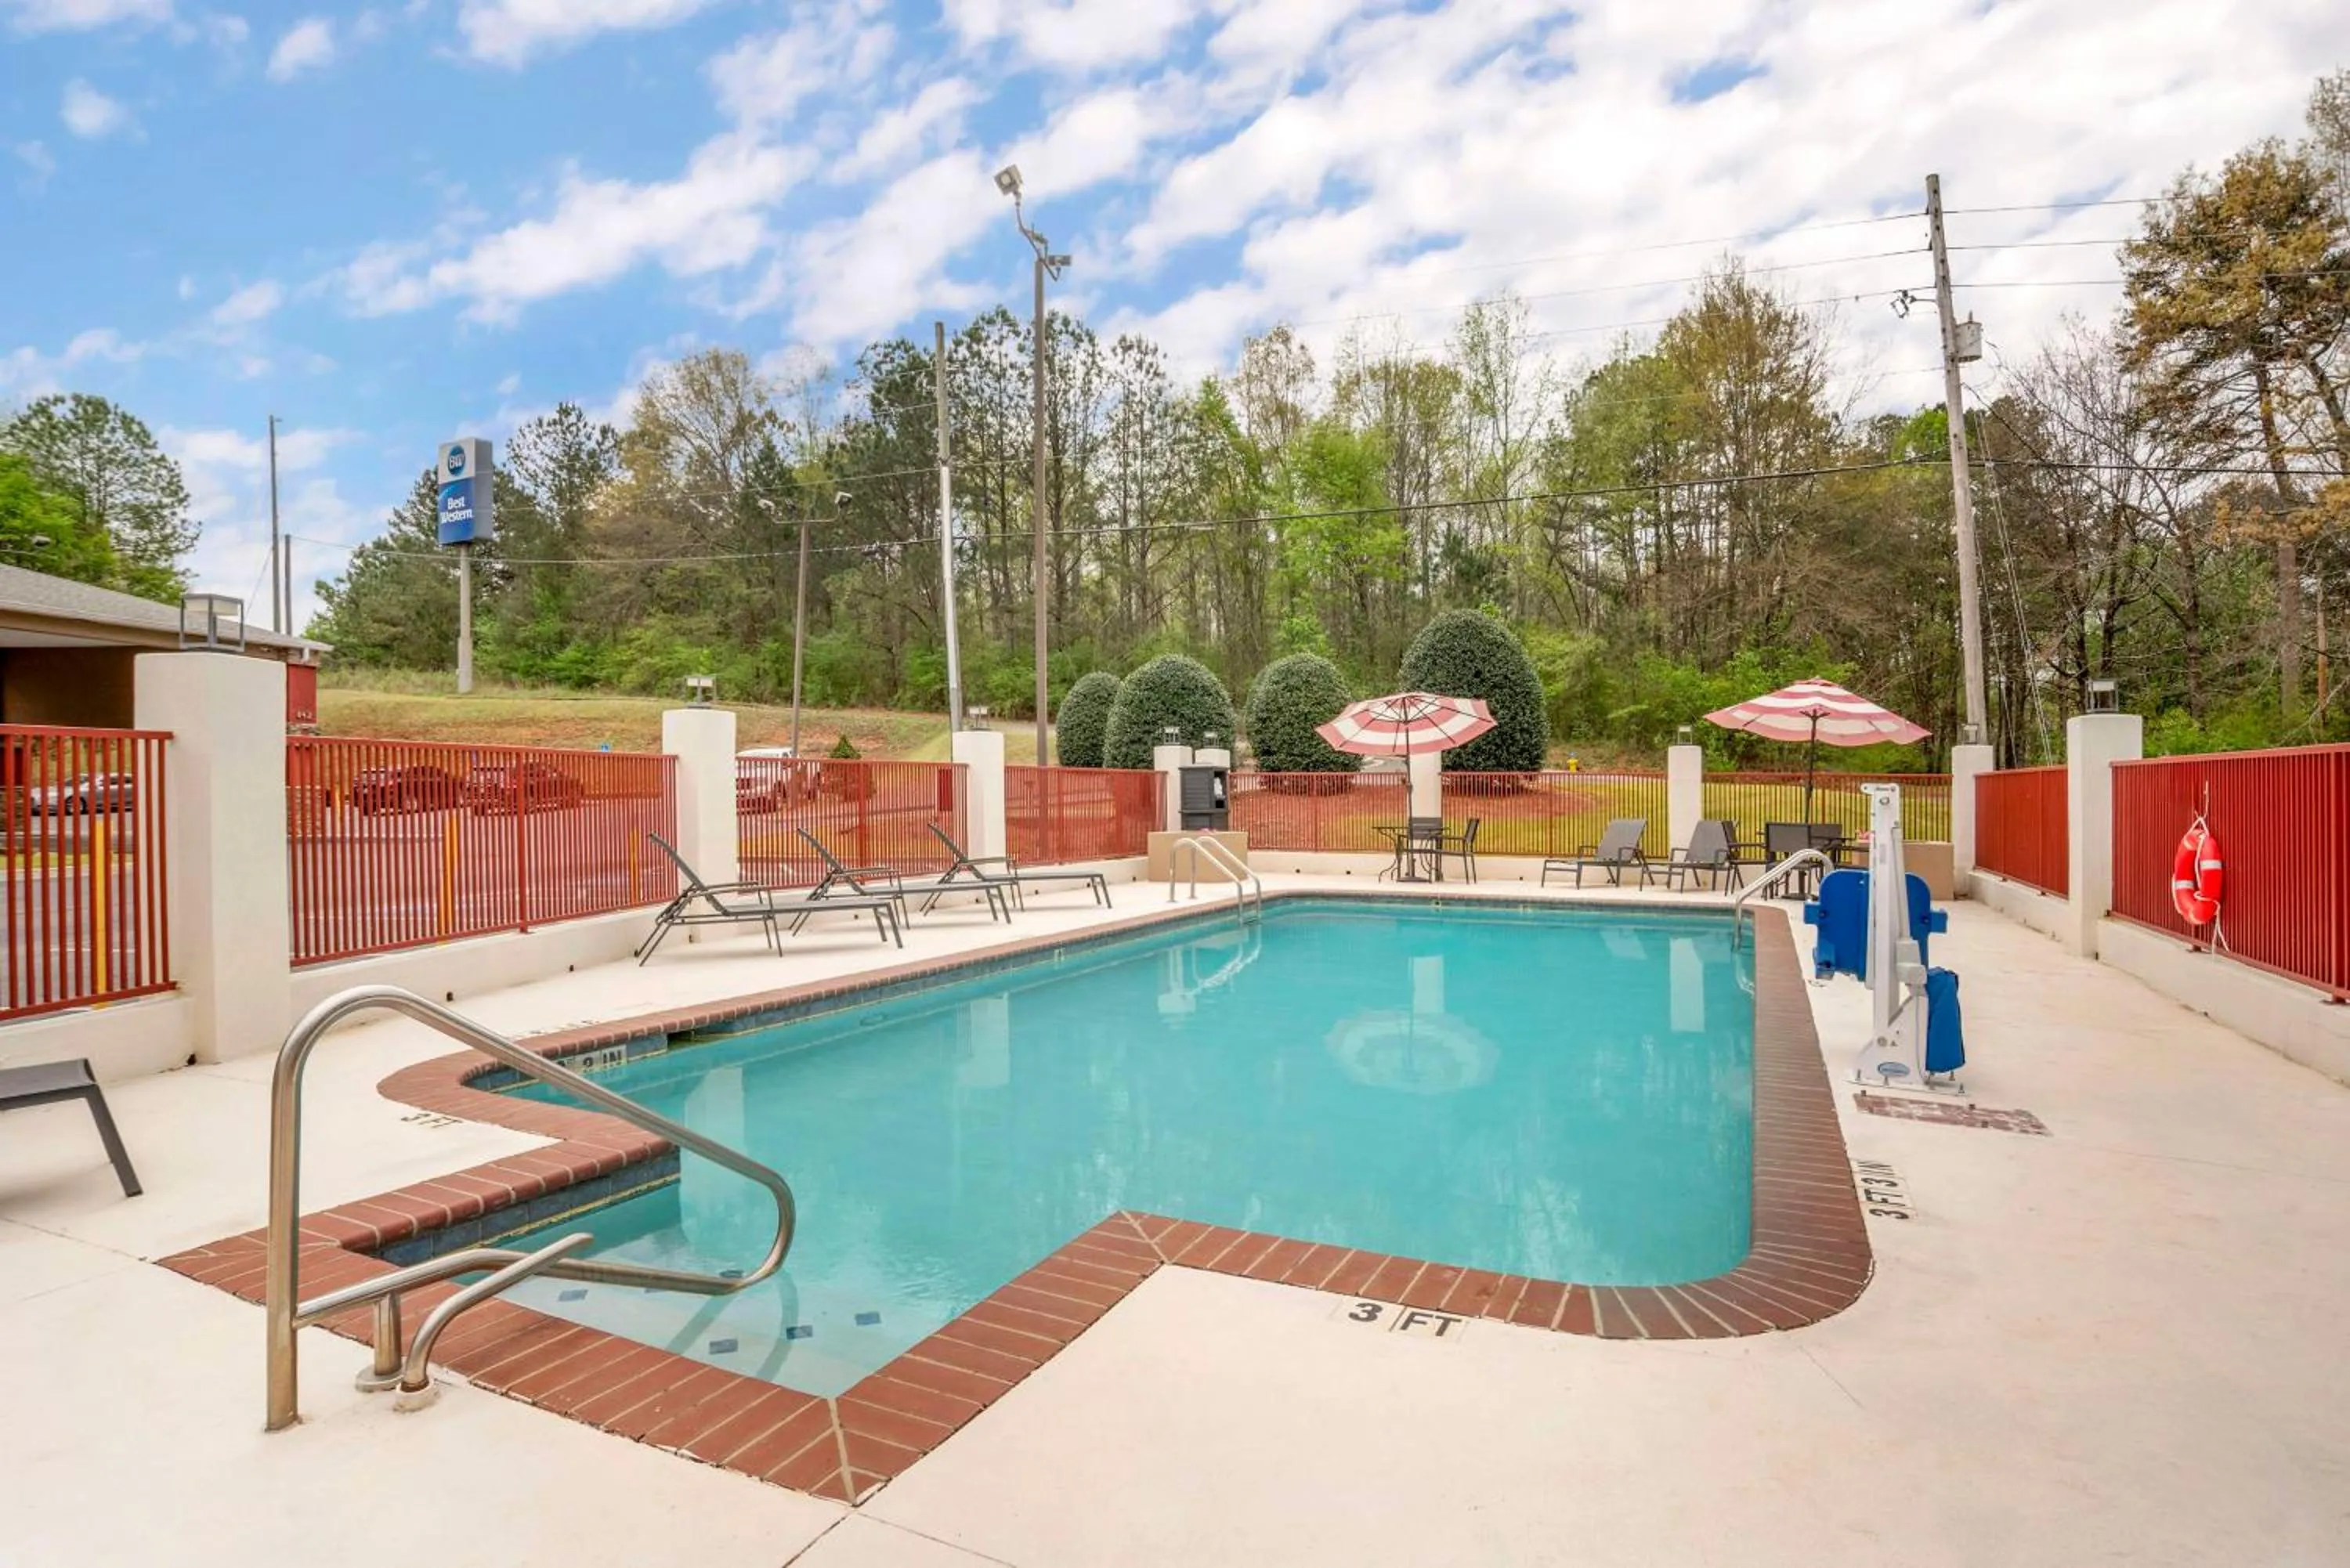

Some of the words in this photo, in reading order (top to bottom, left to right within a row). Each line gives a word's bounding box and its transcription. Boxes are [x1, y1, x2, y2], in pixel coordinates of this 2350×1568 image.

[447, 496, 465, 510] Best
[440, 509, 473, 524] Western
[603, 1050, 621, 1064] IN
[1860, 1177, 1898, 1187] 3
[1864, 1188, 1906, 1207] FT
[1868, 1209, 1910, 1219] 3
[1348, 1302, 1383, 1323] 3
[1400, 1311, 1462, 1337] FT
